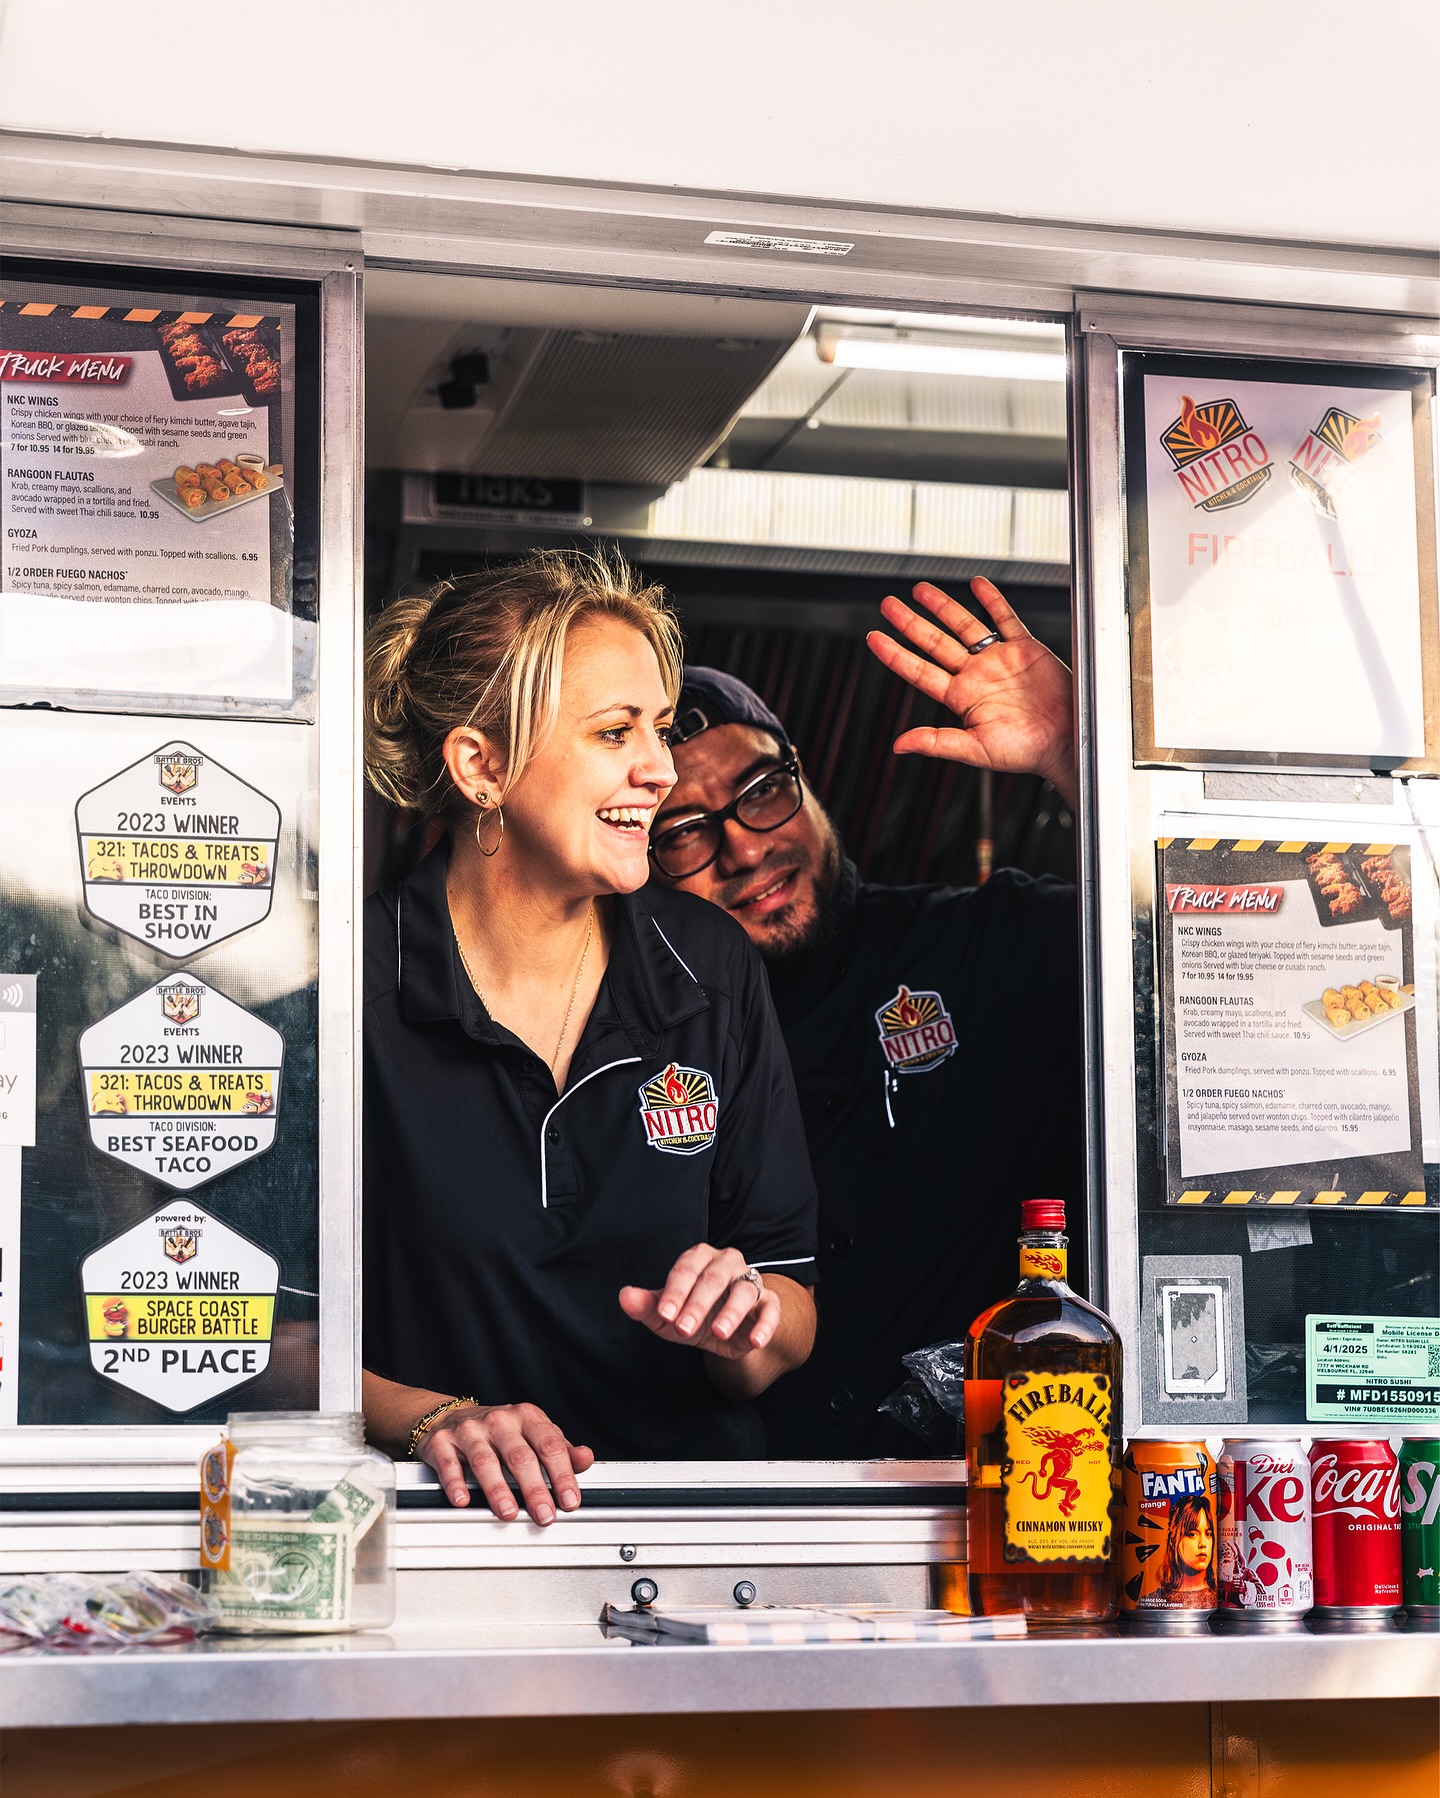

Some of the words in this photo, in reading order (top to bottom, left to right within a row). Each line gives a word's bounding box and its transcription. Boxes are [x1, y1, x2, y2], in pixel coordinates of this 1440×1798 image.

[0, 352, 64, 378] TRUCK
[67, 358, 124, 380] MENU
[7, 395, 25, 404] NKC
[28, 396, 58, 406] WINGS
[11, 408, 32, 418] Crispy
[34, 409, 61, 418] chicken
[63, 411, 84, 422] wings
[86, 412, 101, 420] with
[103, 414, 118, 423] your
[121, 414, 142, 422] choice
[145, 415, 151, 423] of
[153, 415, 168, 426] fiery
[170, 417, 193, 425] kimchi
[195, 418, 216, 427] butter,
[218, 421, 239, 429] agave
[241, 421, 257, 429] tajin,
[17, 444, 28, 452] for
[53, 445, 60, 453] 14
[8, 469, 51, 480] RANGOON
[55, 471, 94, 481] FLAUTAS
[1177, 433, 1268, 503] NITRO
[1208, 490, 1231, 507] KITCHEN
[1236, 471, 1264, 491] COCKTAILS
[12, 505, 36, 514] Served
[39, 506, 54, 515] with
[80, 508, 95, 516] Thai
[97, 508, 111, 517] chili
[113, 510, 136, 518] sauce.
[140, 511, 159, 519] 10.95
[8, 529, 37, 538] GYOZA
[12, 543, 29, 552] Fried
[32, 544, 48, 552] Pork
[50, 545, 89, 556] dumplings,
[91, 547, 115, 555] served
[118, 547, 133, 556] with
[135, 549, 158, 558] ponzu.
[160, 549, 186, 559] Topped
[188, 550, 203, 558] with
[205, 552, 238, 560] scallions.
[242, 553, 258, 561] 6.95
[8, 567, 20, 576] 1/2
[23, 568, 53, 578] ORDER
[56, 569, 86, 578] FUEGO
[183, 757, 202, 765] BROS
[161, 797, 196, 806] EVENTS
[117, 813, 165, 831] 2023
[174, 814, 239, 834] WINNER
[97, 842, 126, 857] 321:
[132, 843, 179, 859] TACOS
[185, 845, 198, 859] &
[205, 845, 259, 861] TREATS
[130, 863, 227, 880] THROWDOWN
[146, 889, 169, 899] TACO
[172, 890, 212, 900] DIVISION:
[1168, 886, 1225, 910] TRUCK
[1229, 888, 1278, 909] MENU
[139, 903, 188, 919] BEST
[195, 905, 217, 921] IN
[145, 923, 212, 939] SHOW
[1178, 927, 1193, 935] NKC
[1196, 928, 1222, 936] WINGS
[1180, 996, 1217, 1005] RANGOON
[1220, 997, 1253, 1005] FLAUTAS
[164, 1028, 199, 1036] EVENTS
[884, 1020, 954, 1062] NITRO
[120, 1045, 169, 1064] 2023
[177, 1045, 243, 1064] WINNER
[1181, 1053, 1207, 1061] GYOZA
[100, 1075, 129, 1090] 321:
[135, 1075, 182, 1090] TACOS
[189, 1075, 203, 1090] &
[209, 1075, 263, 1090] TREATS
[1183, 1089, 1193, 1097] 1/2
[1196, 1089, 1222, 1097] ORDER
[1225, 1089, 1249, 1097] FUEGO
[134, 1095, 231, 1110] THROWDOWN
[150, 1122, 173, 1131] TACO
[176, 1122, 217, 1132] DIVISION:
[644, 1103, 716, 1139] NITRO
[108, 1136, 156, 1151] BEST
[163, 1136, 258, 1152] SEAFOOD
[155, 1157, 211, 1172] TACO
[155, 1215, 191, 1223] powered
[194, 1215, 206, 1223] by:
[121, 1271, 168, 1289] 2023
[176, 1272, 239, 1290] WINNER
[147, 1301, 193, 1317] SPACE
[200, 1301, 249, 1317] COAST
[138, 1318, 195, 1334] BURGER
[203, 1318, 258, 1335] BATTLE
[1323, 1345, 1367, 1354] 4/1/2025
[103, 1348, 150, 1373] 2ND
[162, 1349, 256, 1373] PLACE
[1337, 1389, 1345, 1400] #
[1007, 1383, 1107, 1425] FIREBALL
[1249, 1454, 1295, 1474] Diet
[1142, 1469, 1205, 1496] FANTA
[1217, 1460, 1304, 1523] ke
[1141, 1501, 1166, 1509] orange
[1016, 1521, 1065, 1531] CINNAMON
[1069, 1521, 1103, 1531] WHISKY
